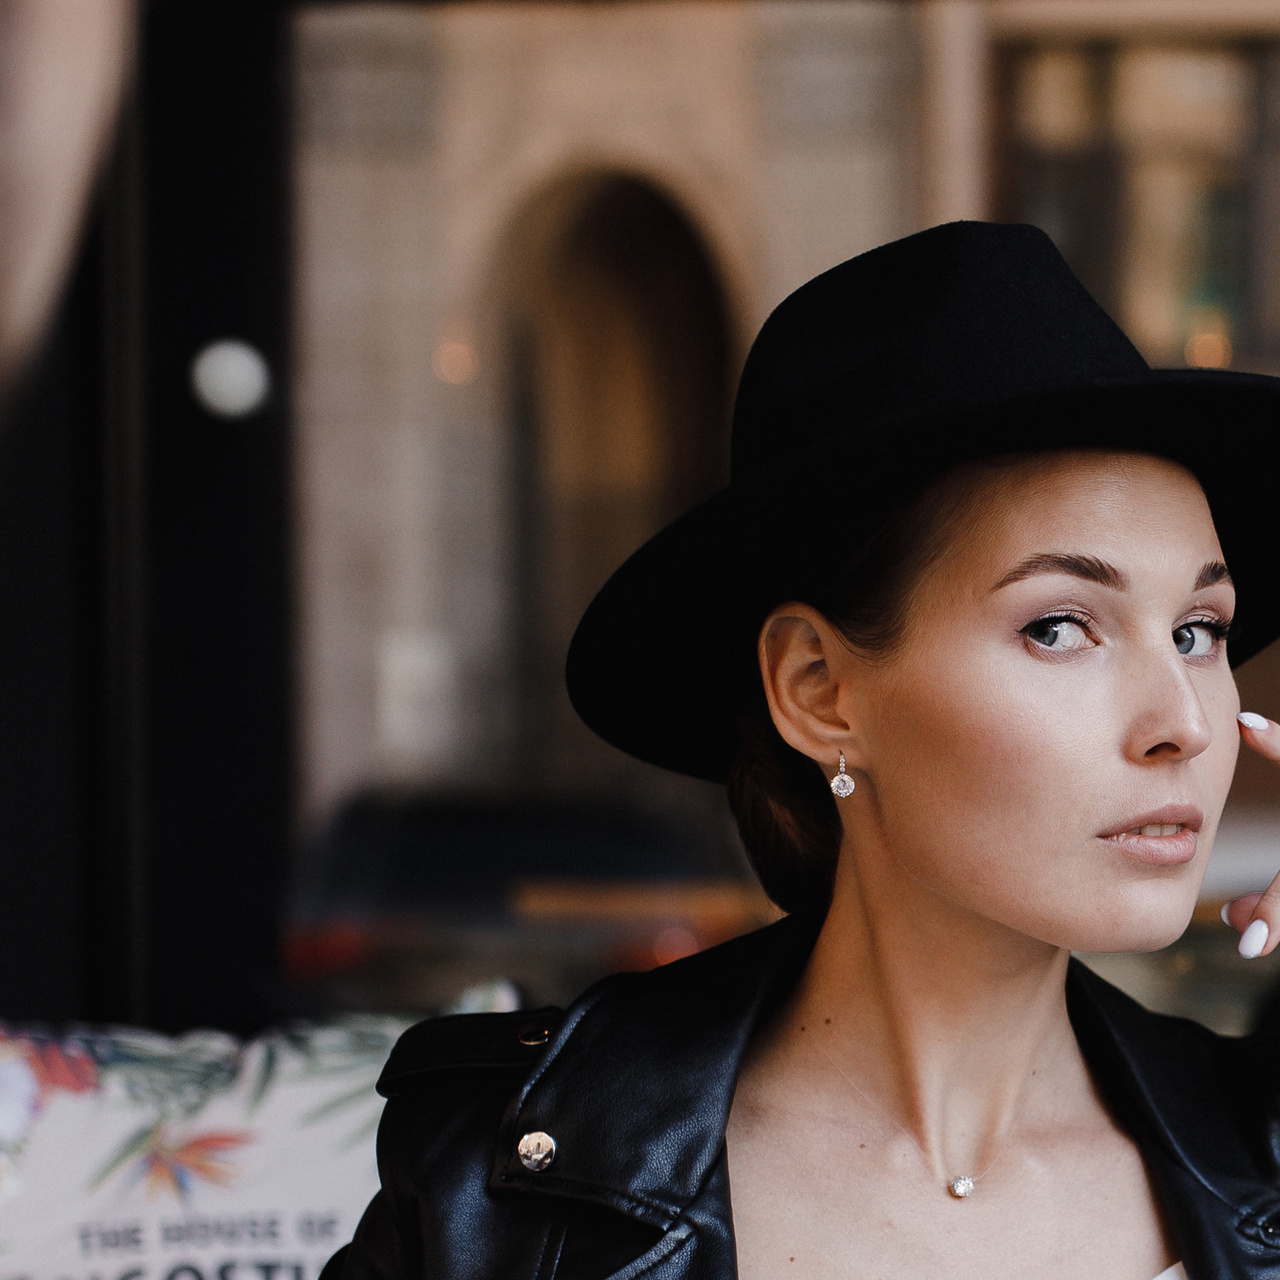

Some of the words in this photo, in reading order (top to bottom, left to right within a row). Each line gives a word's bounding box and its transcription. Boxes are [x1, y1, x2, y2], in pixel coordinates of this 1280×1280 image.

[78, 1218, 143, 1254] THE
[160, 1212, 280, 1247] HOUSE
[298, 1210, 339, 1242] OF
